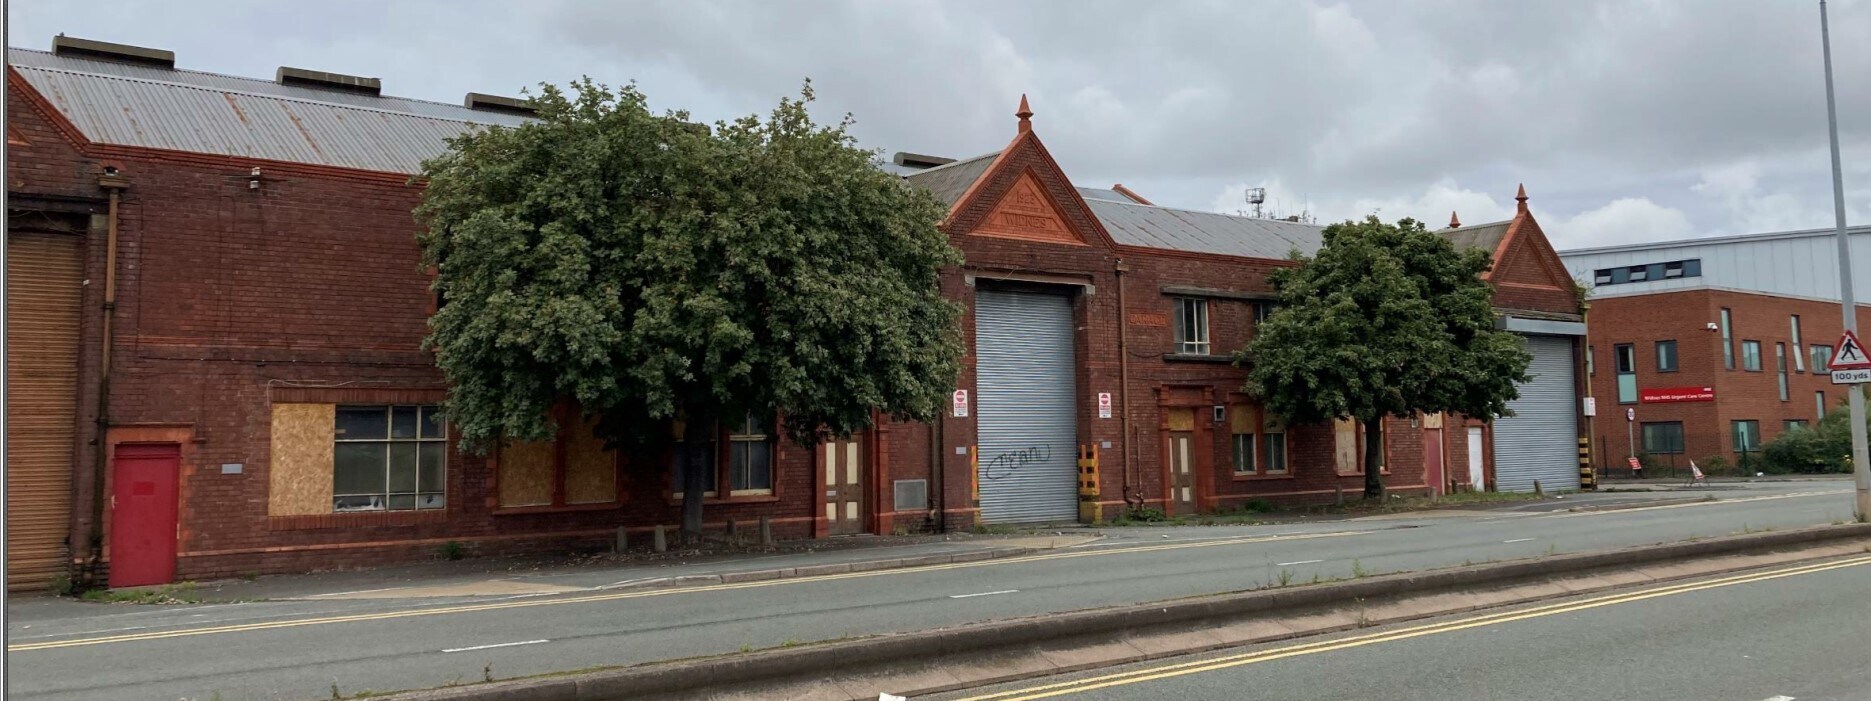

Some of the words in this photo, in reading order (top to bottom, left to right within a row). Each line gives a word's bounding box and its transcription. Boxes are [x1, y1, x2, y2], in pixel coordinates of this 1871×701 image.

[1004, 214, 1047, 229] WIDNES
[1835, 372, 1851, 380] 100
[1853, 372, 1868, 381] yds
